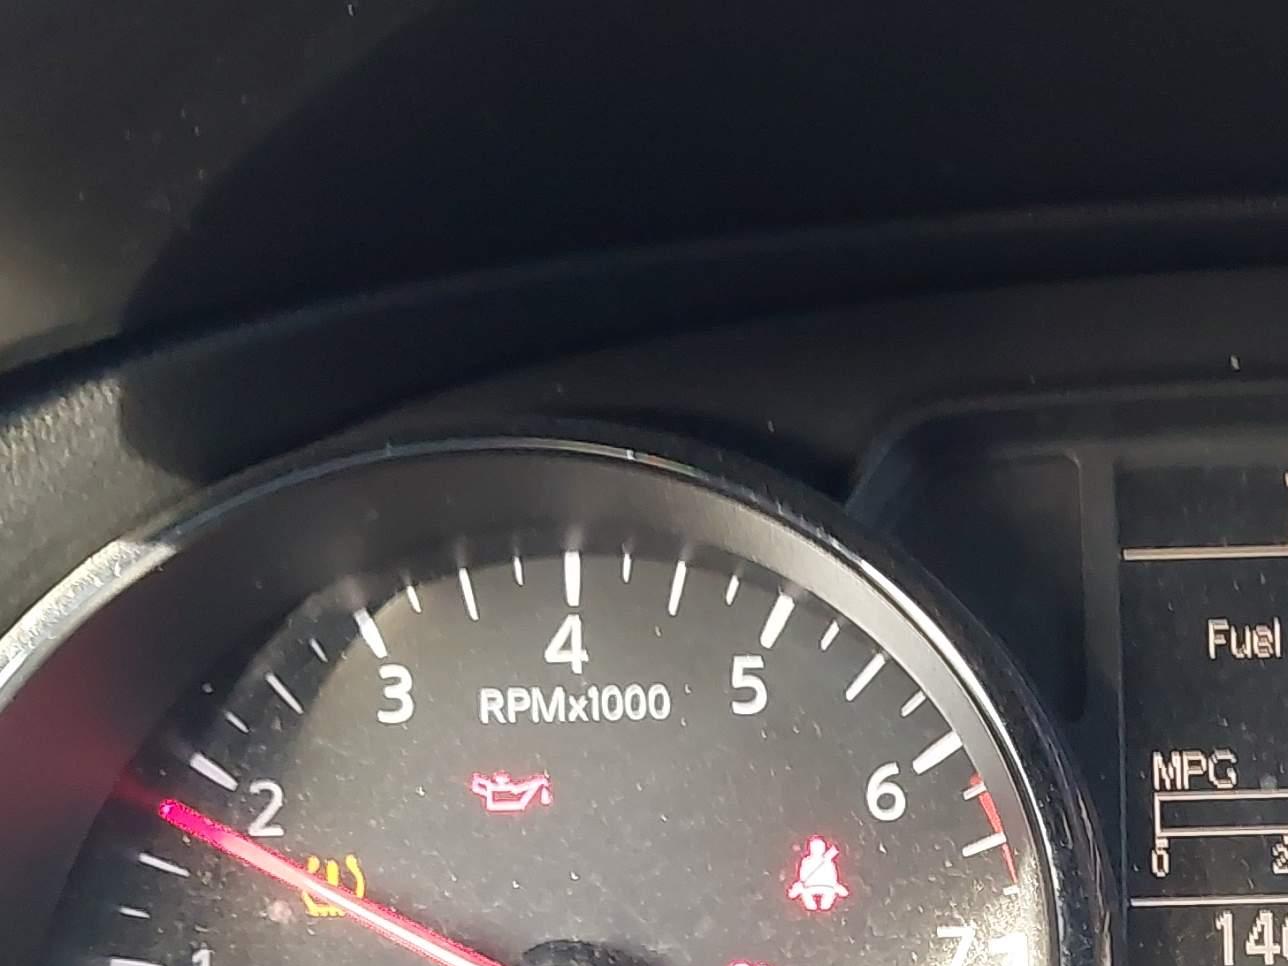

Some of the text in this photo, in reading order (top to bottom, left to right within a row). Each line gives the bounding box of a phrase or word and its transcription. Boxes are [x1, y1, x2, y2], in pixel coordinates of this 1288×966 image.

[545, 614, 588, 674] 4
[1206, 617, 1282, 660] Fuel
[377, 665, 415, 723] 3
[480, 684, 671, 724] RPMx1000
[730, 656, 767, 715] 5
[866, 763, 906, 821] 6
[1152, 748, 1238, 791] MPG
[248, 781, 283, 837] 2
[1151, 847, 1169, 878] 0
